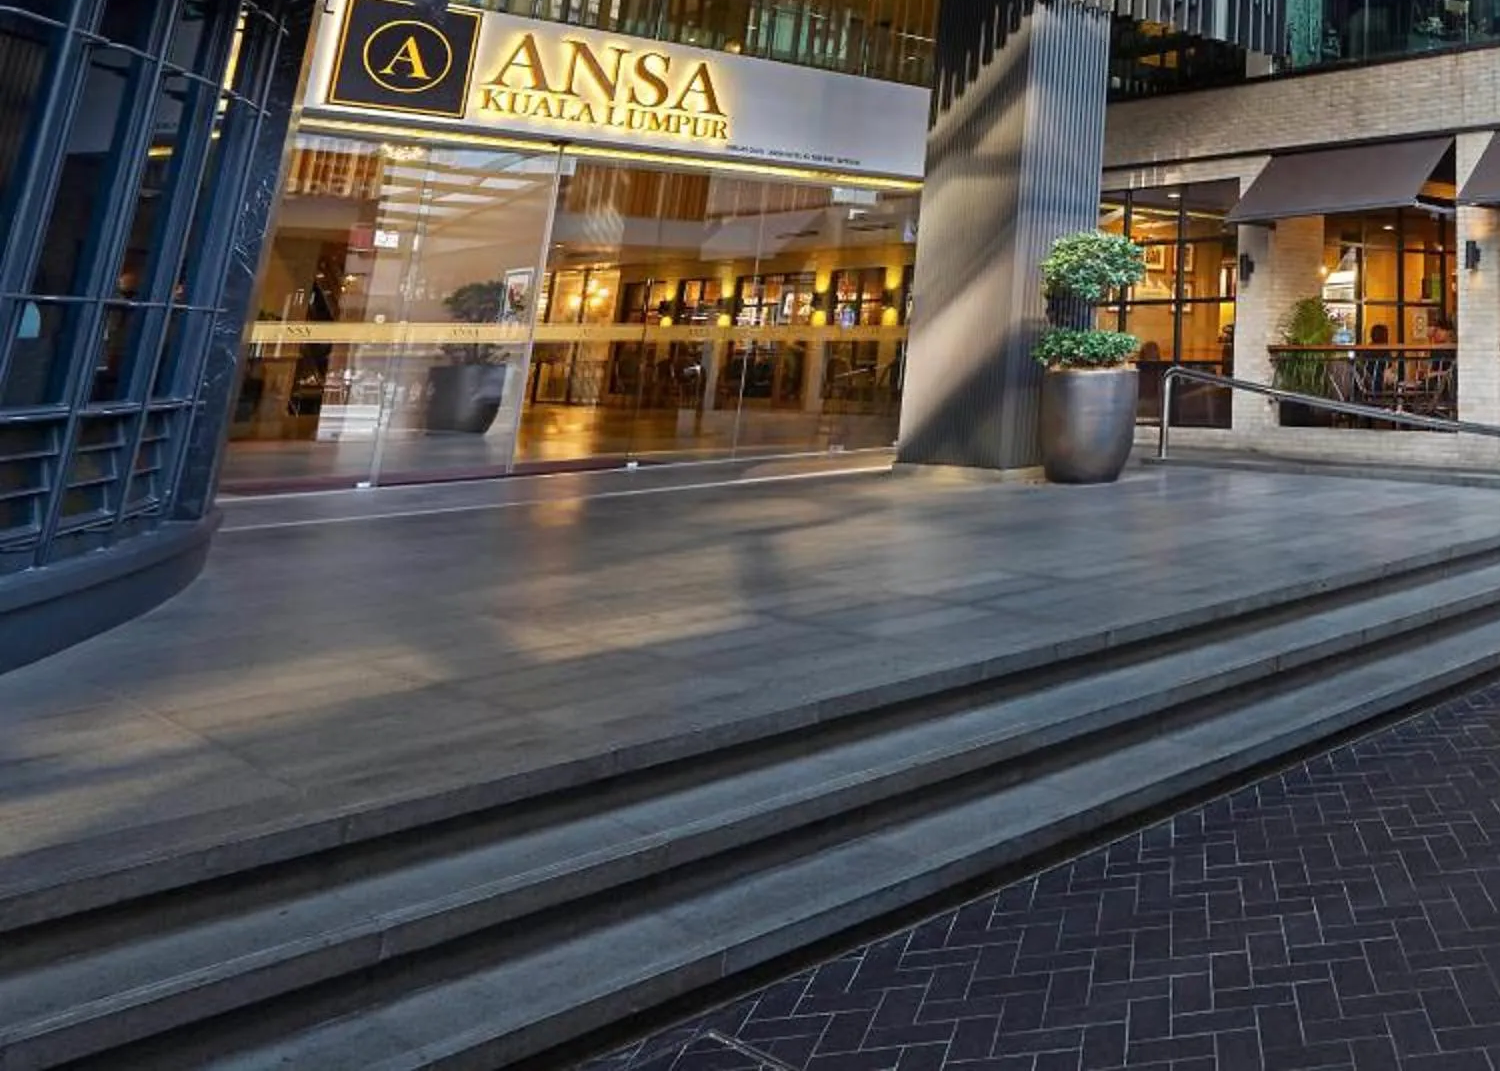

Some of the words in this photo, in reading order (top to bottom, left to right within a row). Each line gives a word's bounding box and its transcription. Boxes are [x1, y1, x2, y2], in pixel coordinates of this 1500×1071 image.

[379, 36, 431, 80] A
[480, 32, 728, 117] ANSA
[480, 88, 597, 124] KUALA
[603, 103, 729, 141] LUMPUR
